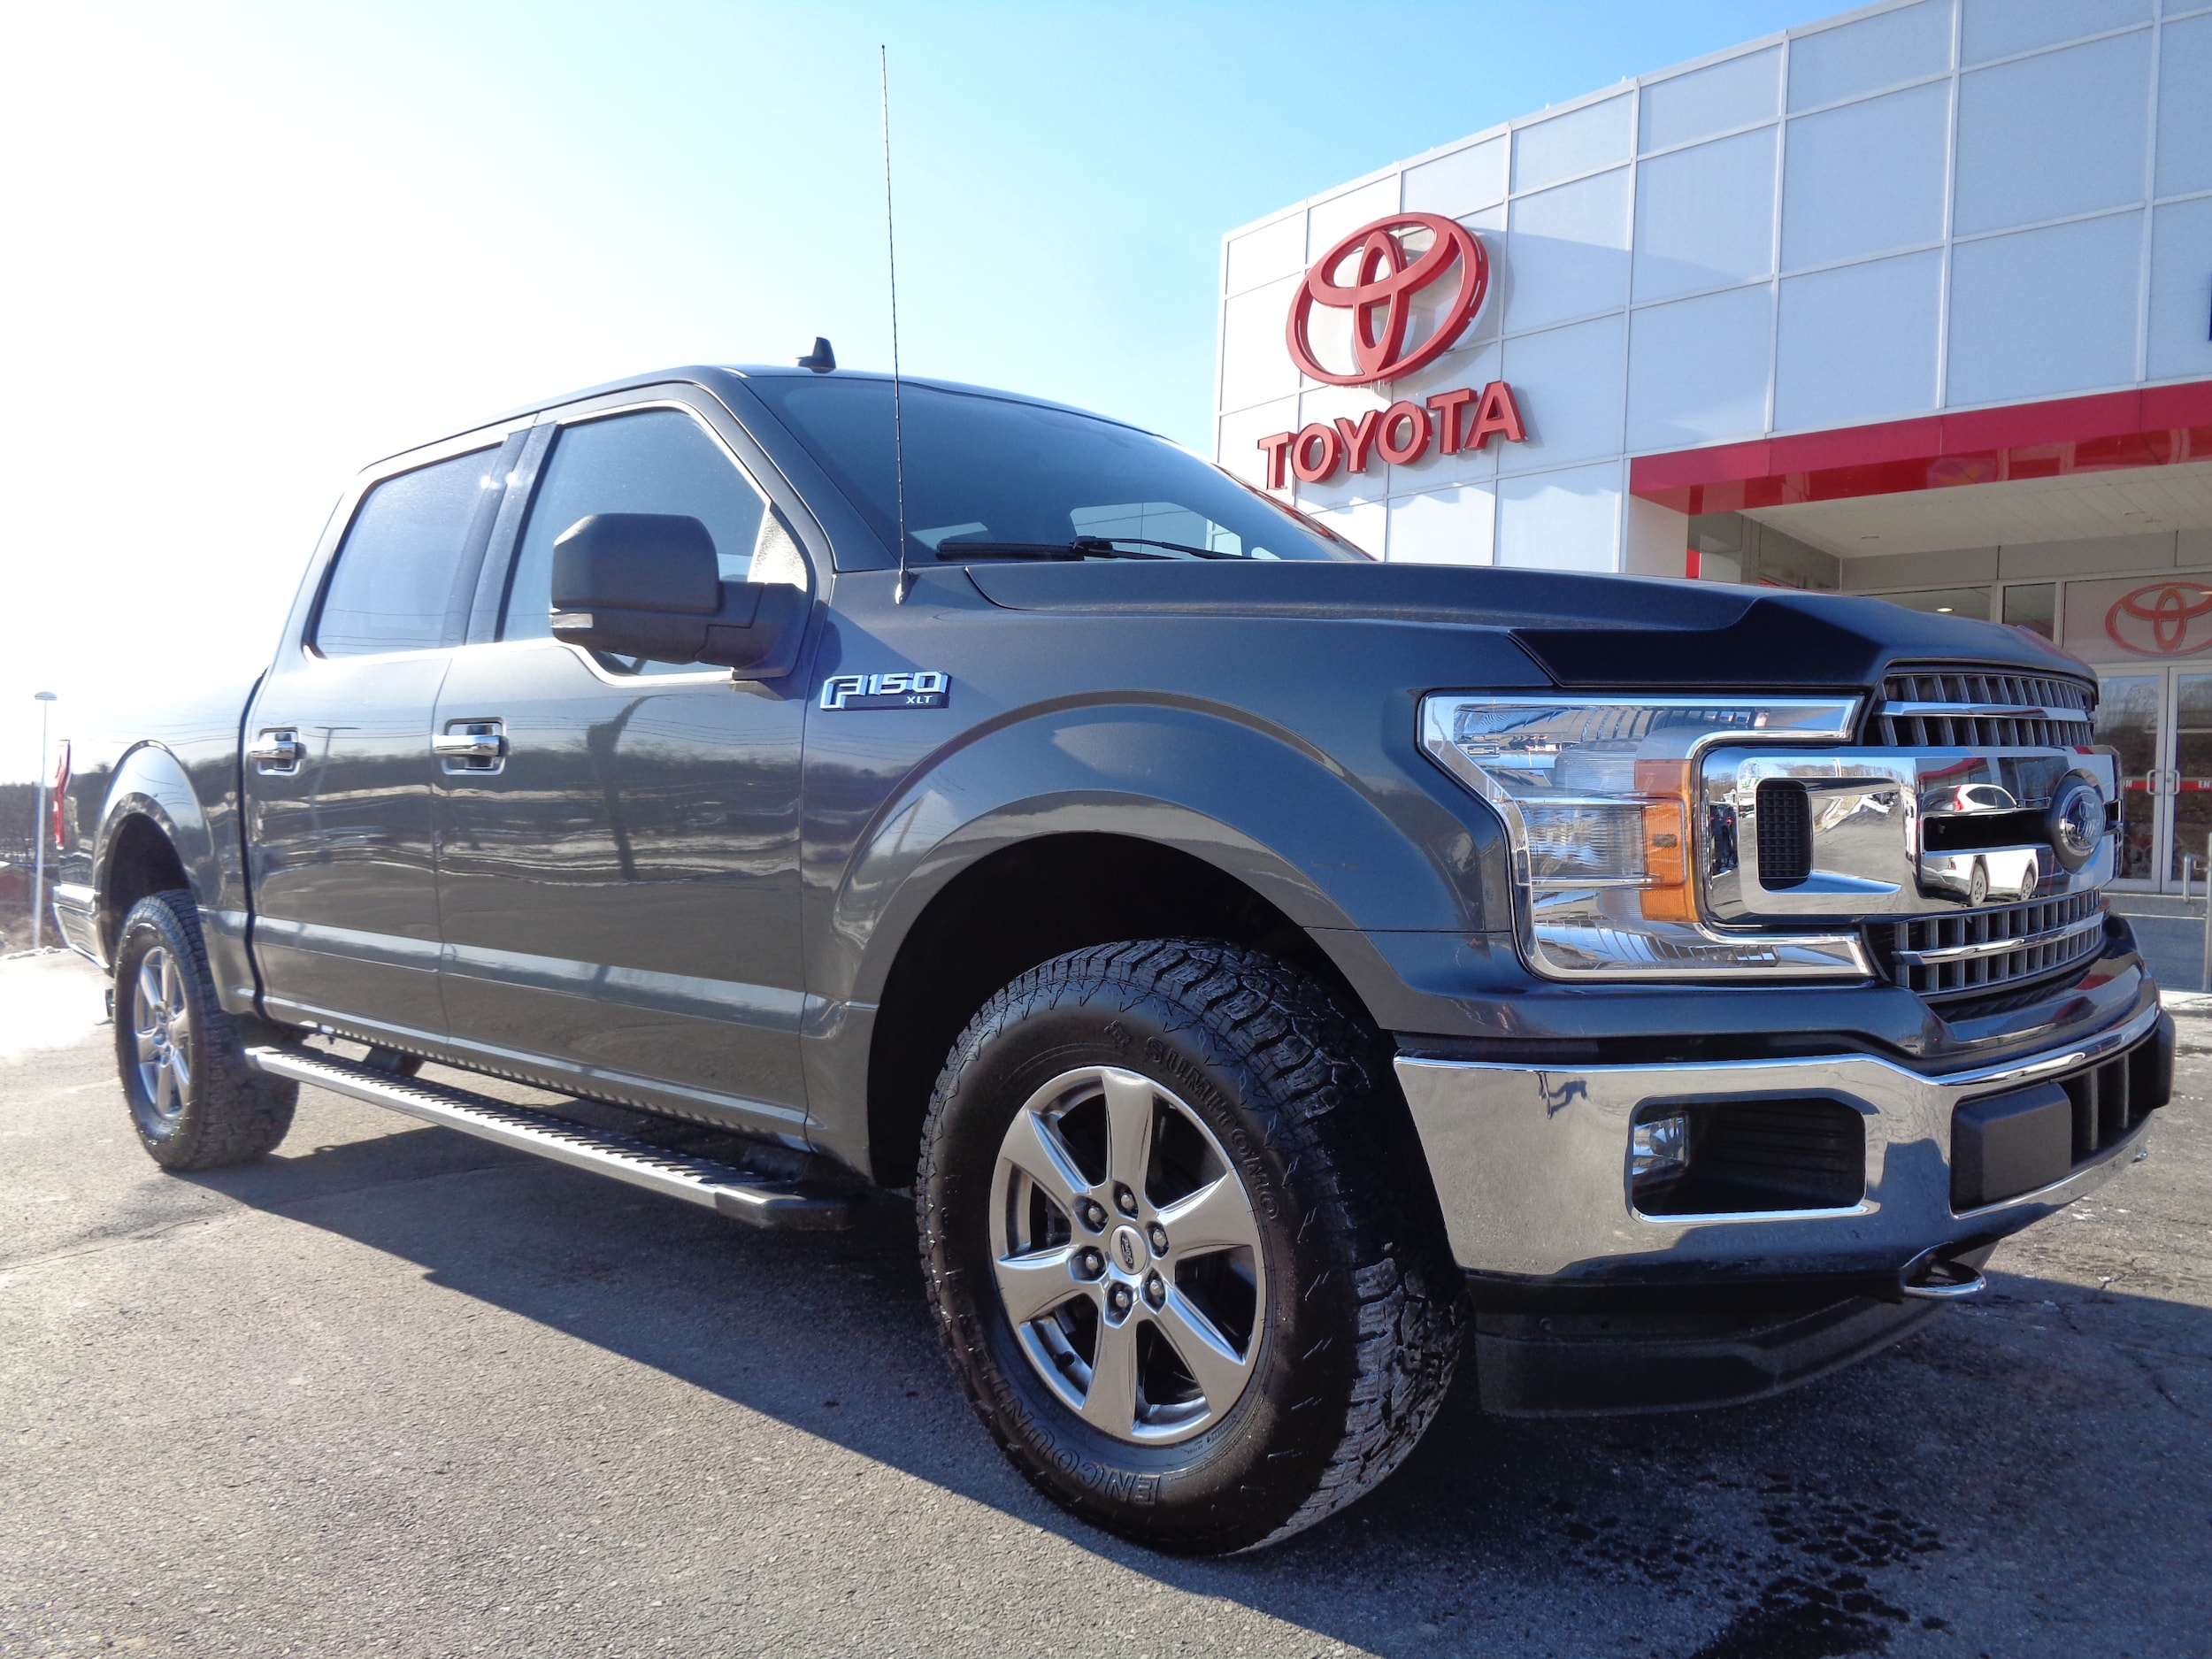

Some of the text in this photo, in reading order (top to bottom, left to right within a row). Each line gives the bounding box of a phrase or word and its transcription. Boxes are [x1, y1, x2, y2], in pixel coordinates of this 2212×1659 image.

[1257, 380, 1528, 490] TOYOTA
[906, 695, 933, 704] XLT
[1144, 1035, 1279, 1221] SUMITOMO
[1120, 1236, 1133, 1264] Ford
